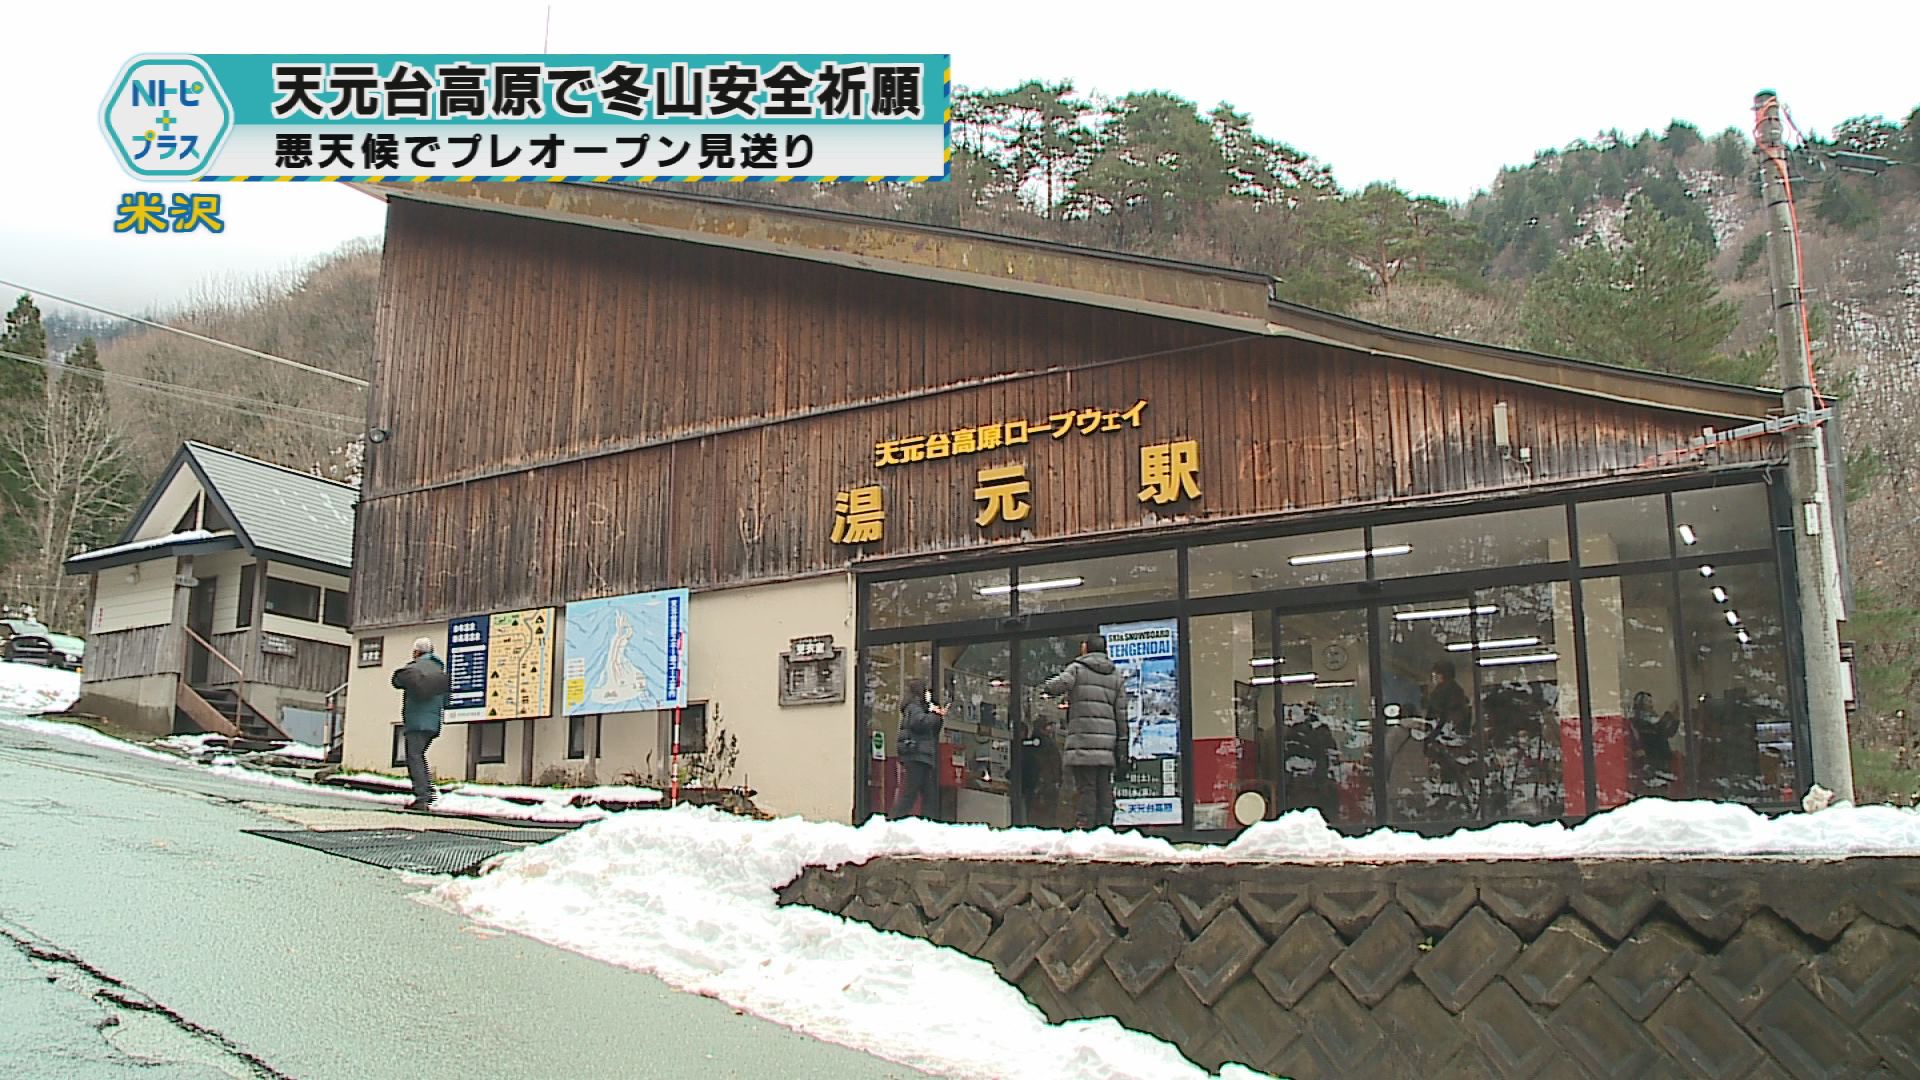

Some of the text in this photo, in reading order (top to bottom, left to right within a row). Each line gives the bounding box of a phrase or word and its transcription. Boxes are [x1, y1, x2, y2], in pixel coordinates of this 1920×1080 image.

[875, 400, 1149, 467] 天元台高原ロープウェイ
[1109, 640, 1171, 657] TENGENDAI
